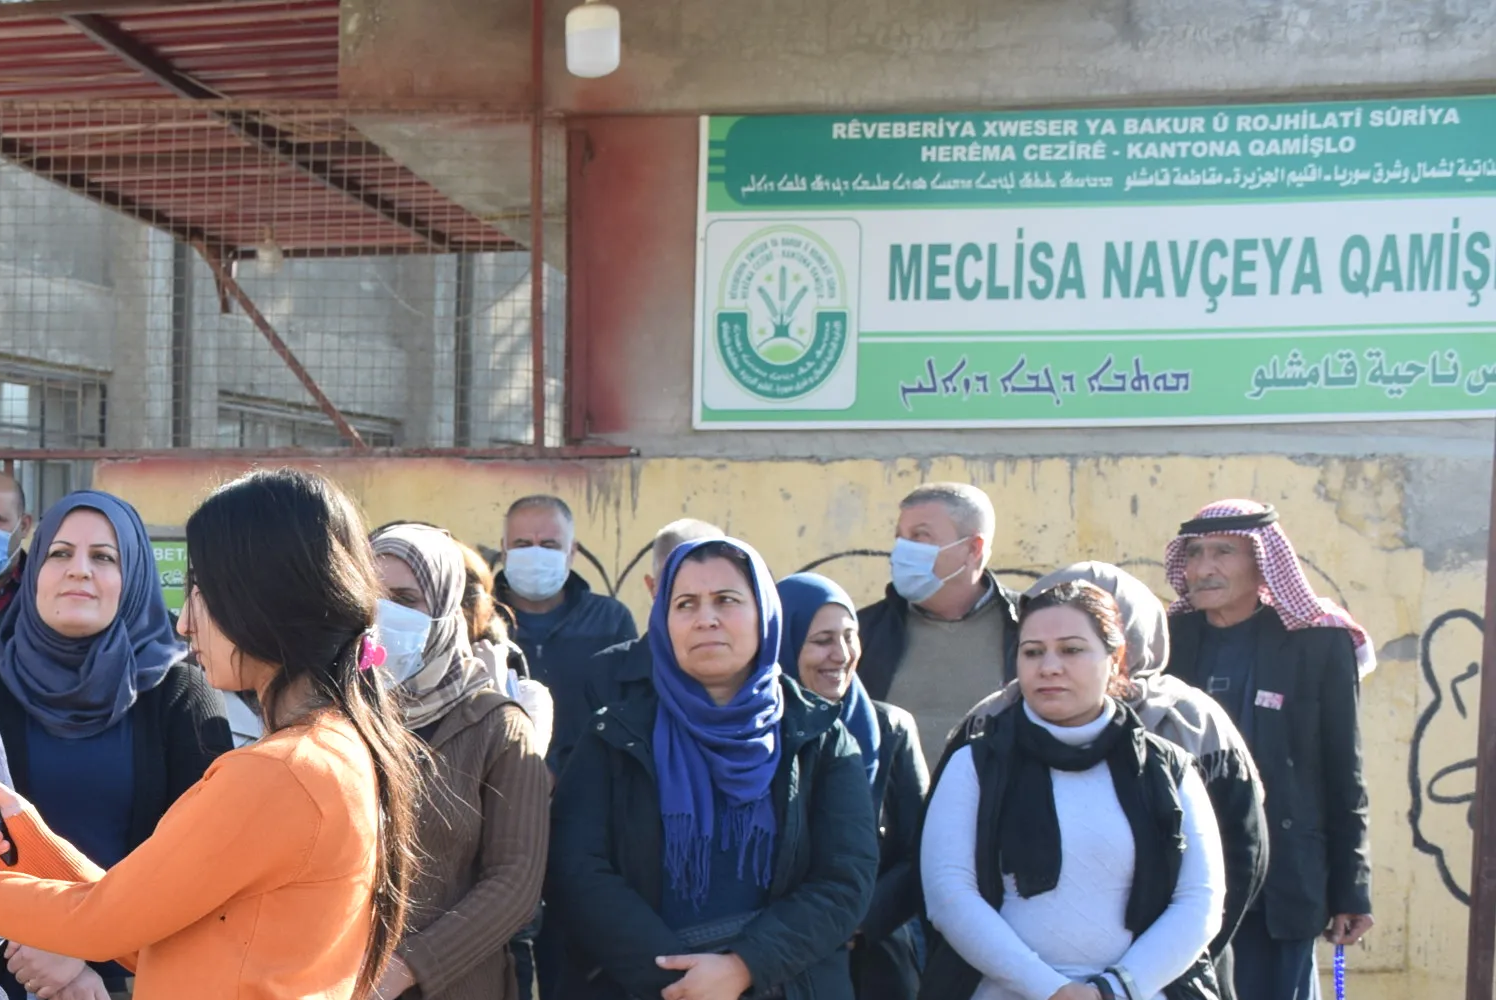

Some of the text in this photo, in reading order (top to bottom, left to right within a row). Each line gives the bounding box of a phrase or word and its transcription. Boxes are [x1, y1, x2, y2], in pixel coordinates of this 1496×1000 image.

[983, 120, 1077, 138] XWESER
[1085, 119, 1117, 136] YA
[1123, 117, 1205, 135] BAKUR
[1212, 112, 1229, 133] Û
[920, 141, 1016, 162] HERÊMA
[1126, 140, 1241, 160] KANTONA
[1248, 134, 1357, 158] QAMİŞLO
[1124, 167, 1172, 192] قامشلو
[1172, 167, 1223, 187] مقاطعة
[1333, 164, 1372, 187] سوريا
[1372, 158, 1410, 184] وشرق
[1411, 157, 1454, 184] لشمال
[1456, 158, 1496, 183] ذاتية
[888, 227, 1087, 301] MECLİSA
[1103, 237, 1323, 313] NAVÇEYA
[1339, 217, 1496, 307] QAMİŞ
[1245, 349, 1358, 398] قامشلو
[1364, 348, 1460, 398] ناحية
